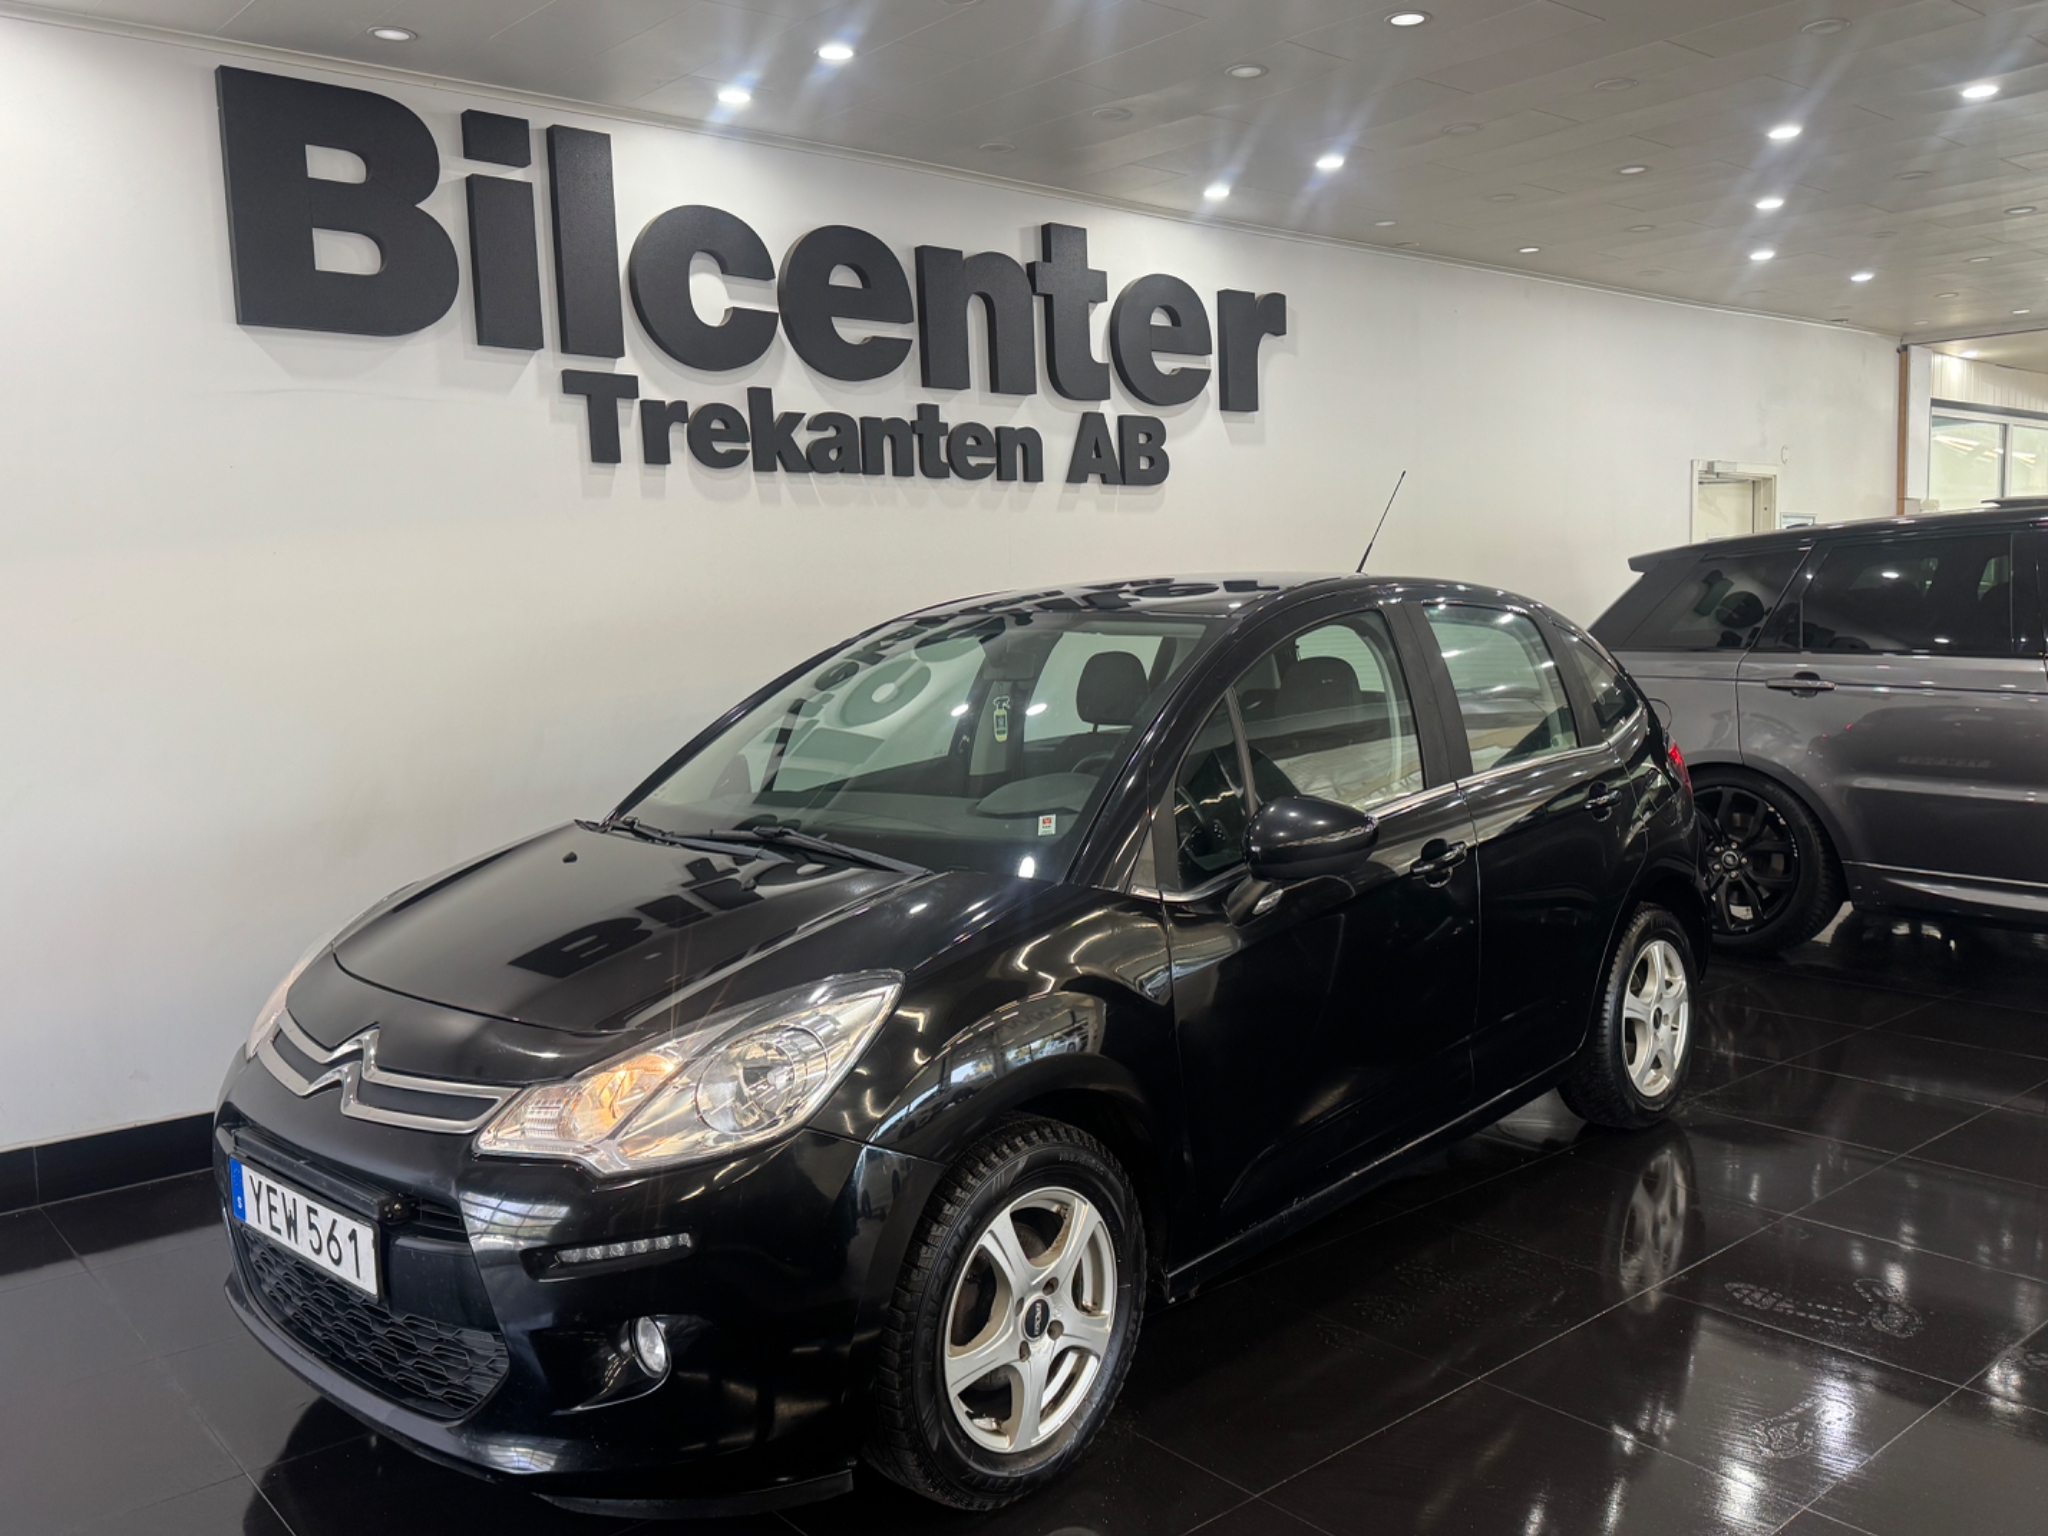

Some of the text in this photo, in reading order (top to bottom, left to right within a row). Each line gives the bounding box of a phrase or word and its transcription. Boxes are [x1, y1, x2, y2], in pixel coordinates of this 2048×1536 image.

[215, 64, 1288, 412] Bilcenter
[562, 369, 1171, 486] Trekanten AB
[249, 1174, 361, 1280] YEW 561
